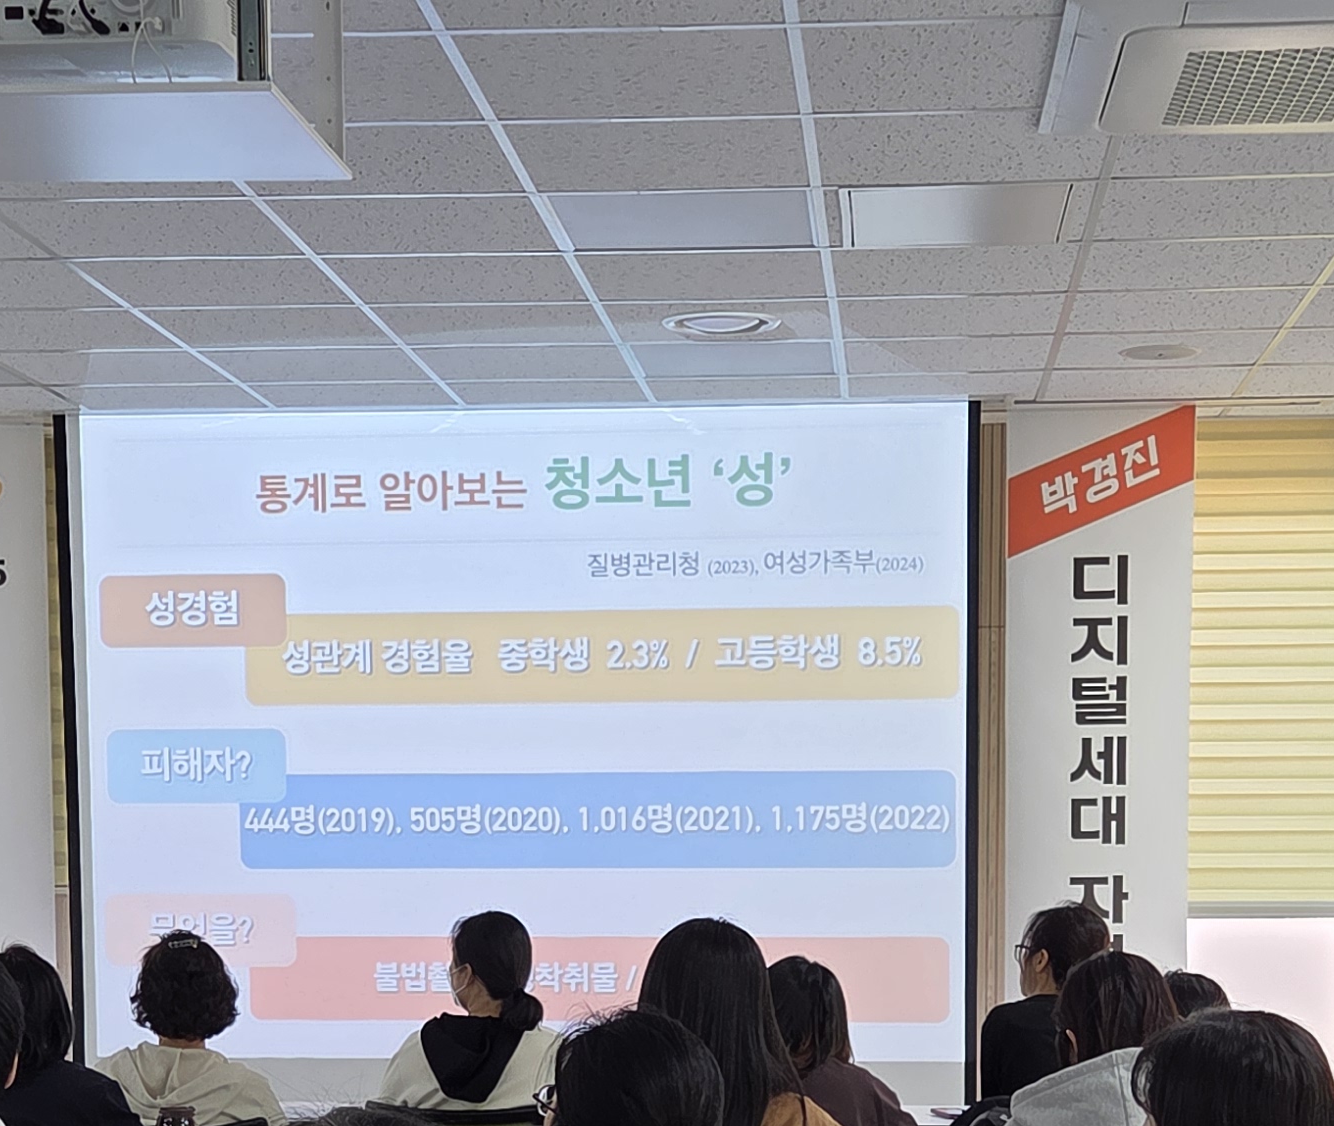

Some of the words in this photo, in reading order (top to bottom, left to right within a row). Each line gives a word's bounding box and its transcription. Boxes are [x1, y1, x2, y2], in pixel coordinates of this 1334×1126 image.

[256, 472, 367, 514] 통계로
[379, 470, 528, 512] 알아보는
[544, 453, 692, 511] 청소년
[1040, 434, 1161, 516] 박경진
[586, 551, 700, 578] 질병관리청
[707, 558, 760, 578] (2023),
[763, 549, 925, 576] 여성가족부(2024)
[144, 590, 240, 628] 성경험
[282, 638, 373, 675] 성관계
[381, 638, 473, 675] 경험율
[497, 636, 590, 673] 중학생
[606, 638, 669, 670] 2.3%
[684, 637, 699, 669] /
[714, 633, 840, 671] 고등학생
[856, 634, 923, 667] 8.5%
[1069, 554, 1130, 846] 디지털세대
[140, 746, 252, 783] 피해자?
[244, 804, 403, 837] 444명(2019),
[410, 803, 570, 837] 505명(2020),
[771, 801, 951, 834] 1,175명(2022)
[1069, 874, 1130, 952] 자
